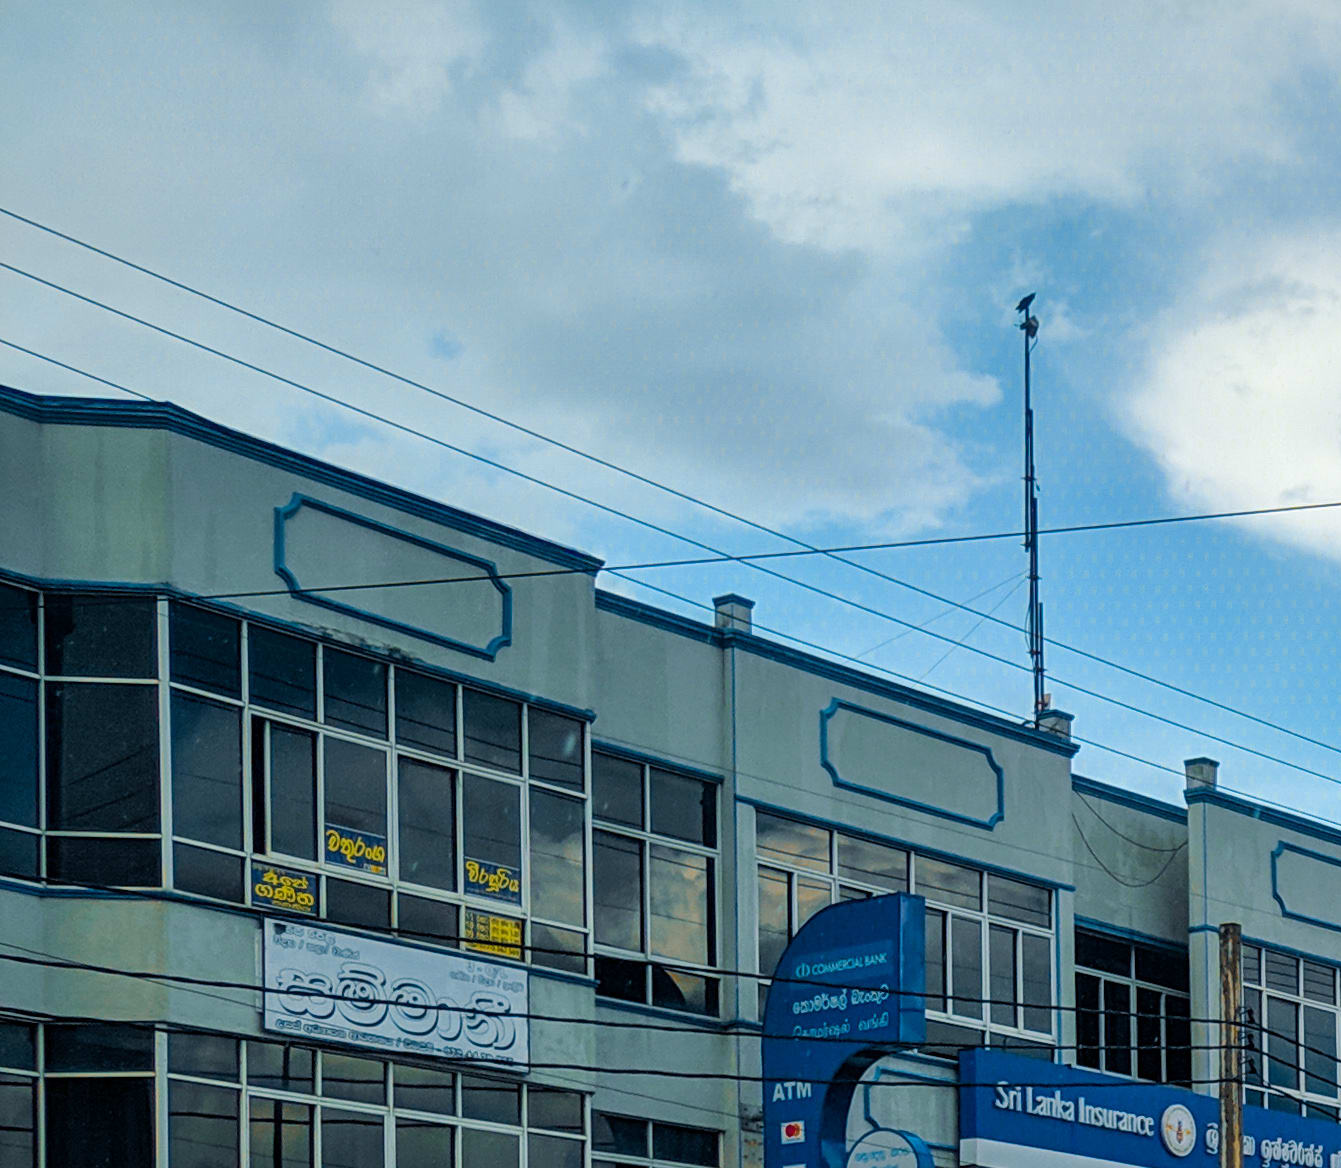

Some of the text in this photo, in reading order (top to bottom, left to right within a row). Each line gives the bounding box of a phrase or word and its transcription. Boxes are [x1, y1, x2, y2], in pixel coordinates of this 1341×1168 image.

[811, 952, 888, 975] COMMERCIAL BANK
[773, 1082, 812, 1102] ATM
[995, 1081, 1154, 1136] Sri Lanka Insurance
